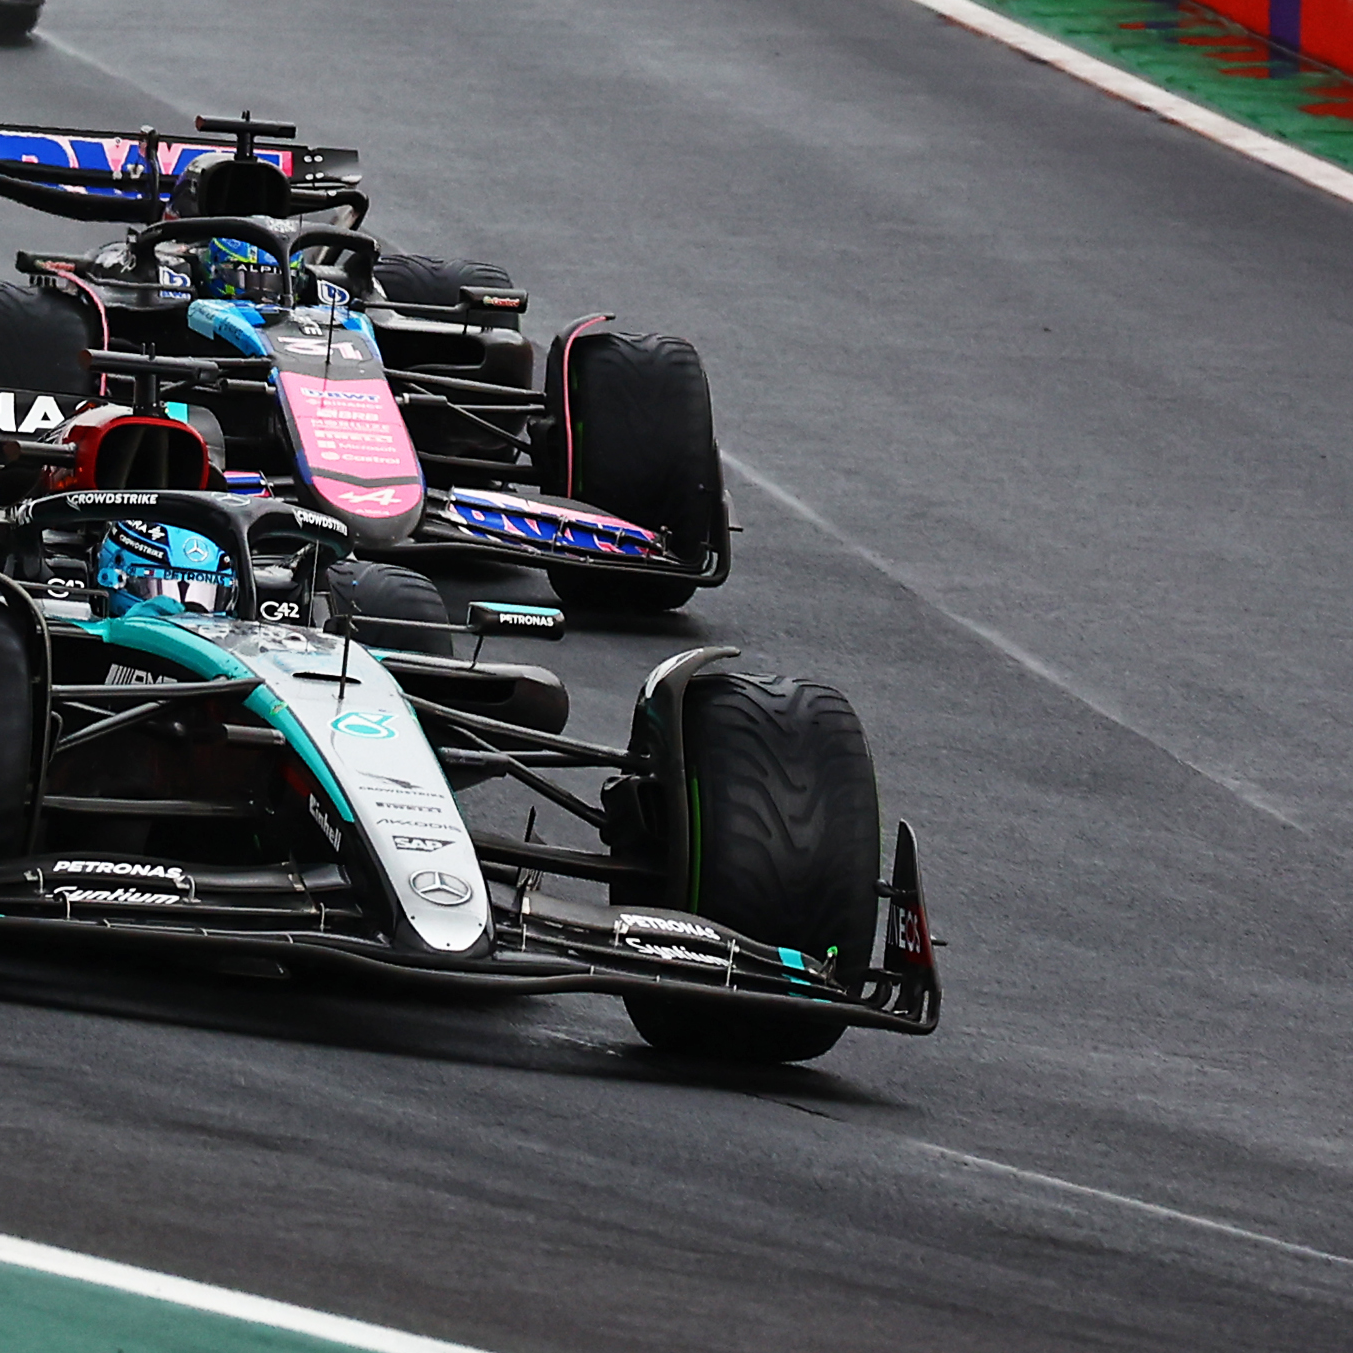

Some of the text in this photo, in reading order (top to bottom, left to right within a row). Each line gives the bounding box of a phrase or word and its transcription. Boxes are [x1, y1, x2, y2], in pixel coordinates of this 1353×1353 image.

[236, 264, 283, 275] ALPI
[341, 453, 401, 465] Castrol
[71, 492, 159, 506] CROWDSTRIKE
[118, 534, 165, 560] CROWDSTRIKE
[163, 569, 227, 585] PETRONAS
[259, 601, 301, 621] G42
[499, 613, 555, 628] PETRONAS
[358, 785, 446, 799] CROWDSTRIKE
[308, 792, 342, 853] Einhell
[396, 836, 443, 851] SAP
[52, 859, 184, 881] PETRONAS
[47, 885, 182, 907] Syntium
[620, 913, 721, 942] PETRONAS
[625, 937, 734, 968] Syntium
